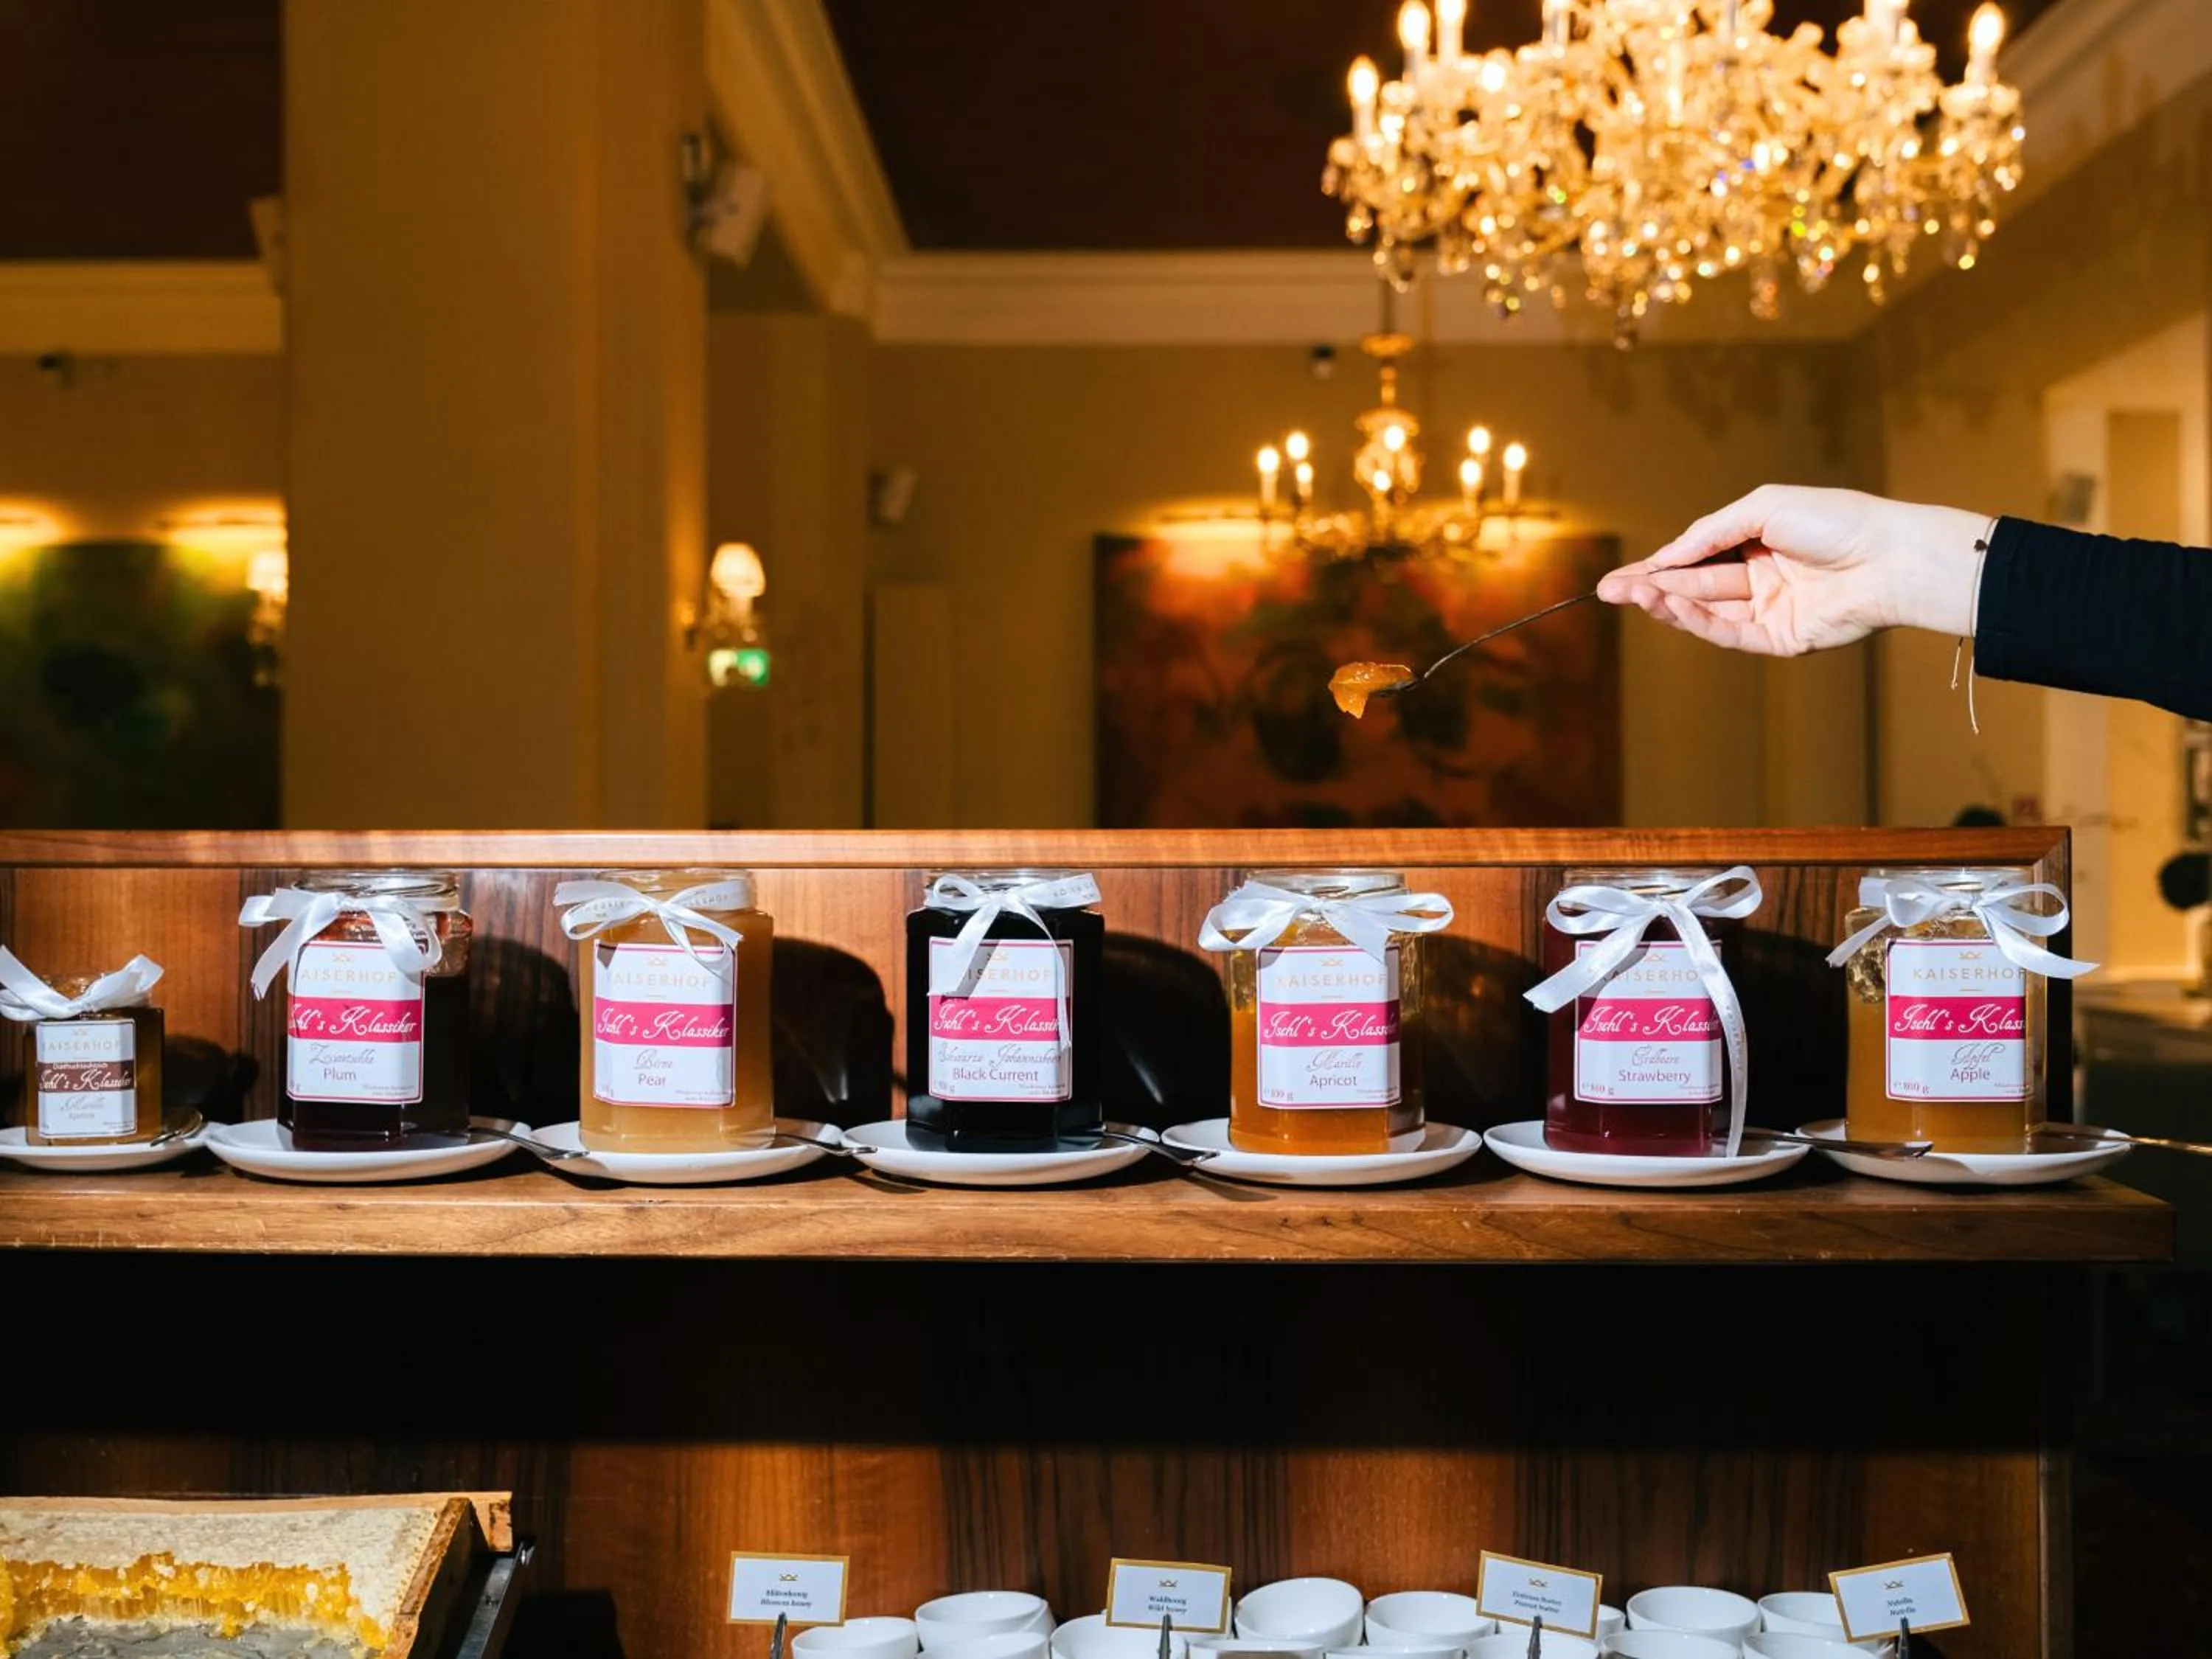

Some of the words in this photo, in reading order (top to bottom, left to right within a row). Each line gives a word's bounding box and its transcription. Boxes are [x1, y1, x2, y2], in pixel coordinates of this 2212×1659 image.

[299, 968, 398, 984] AISERHOF
[967, 967, 1053, 982] ISERHOF
[1602, 969, 1699, 983] AISERHO
[329, 1005, 417, 1036] Klassiker
[642, 1010, 730, 1041] Klassiker
[323, 1066, 357, 1081] Plum
[637, 1072, 666, 1087] Pear
[952, 1068, 987, 1081] Black
[989, 1068, 1039, 1082] Current
[1618, 1068, 1691, 1084] Strawberry
[1950, 1068, 1992, 1083] Apple
[1309, 1074, 1358, 1091] Apricot
